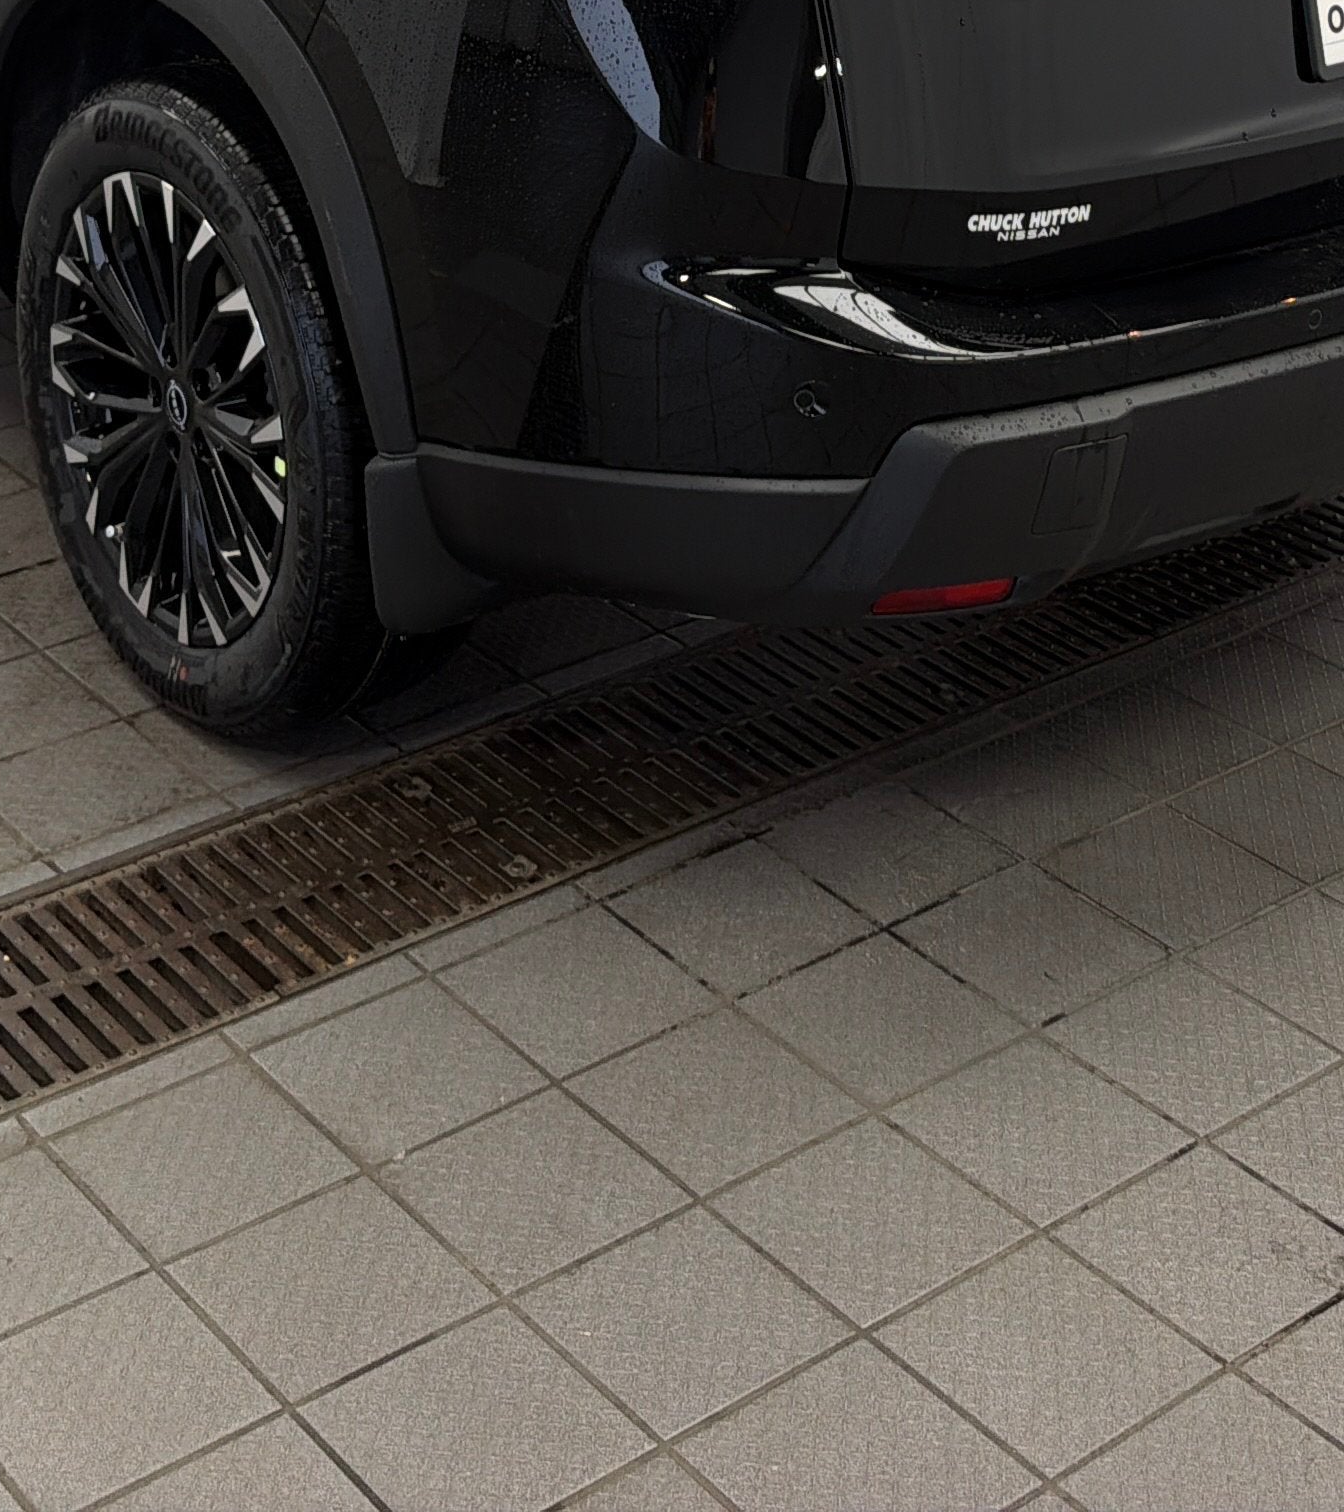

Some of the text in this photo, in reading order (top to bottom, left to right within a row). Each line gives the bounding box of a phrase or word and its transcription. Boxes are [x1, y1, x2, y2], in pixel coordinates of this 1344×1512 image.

[967, 204, 1092, 232] CHUCK HUTTON
[996, 226, 1061, 242] NISSAN
